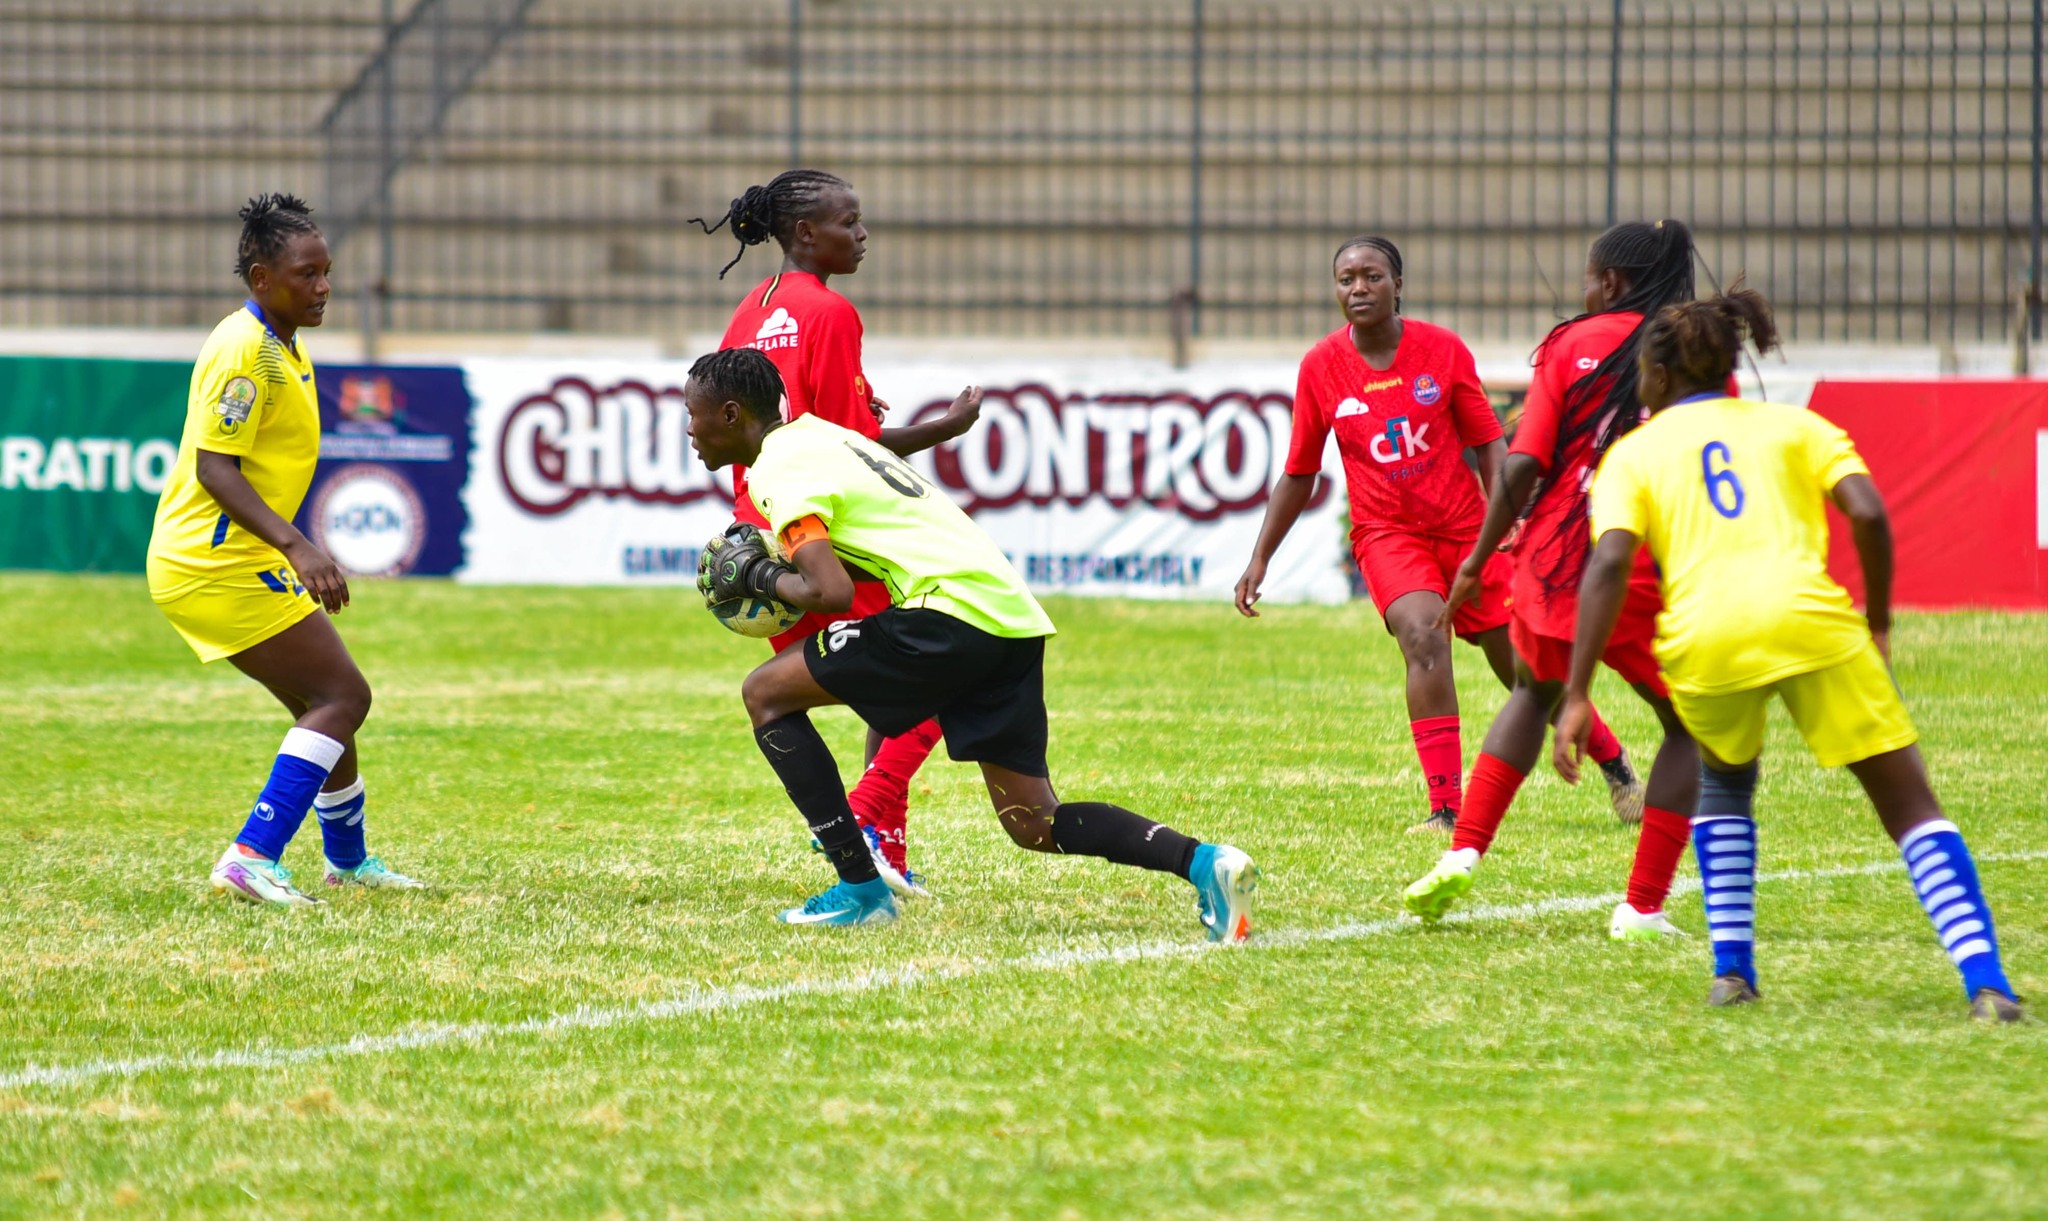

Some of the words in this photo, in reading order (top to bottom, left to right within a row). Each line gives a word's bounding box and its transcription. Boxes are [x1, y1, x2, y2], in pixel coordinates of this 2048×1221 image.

[1363, 377, 1403, 393] uhlsport
[1, 435, 178, 495] RATIO
[1702, 440, 1745, 519] 6
[785, 518, 806, 548] C
